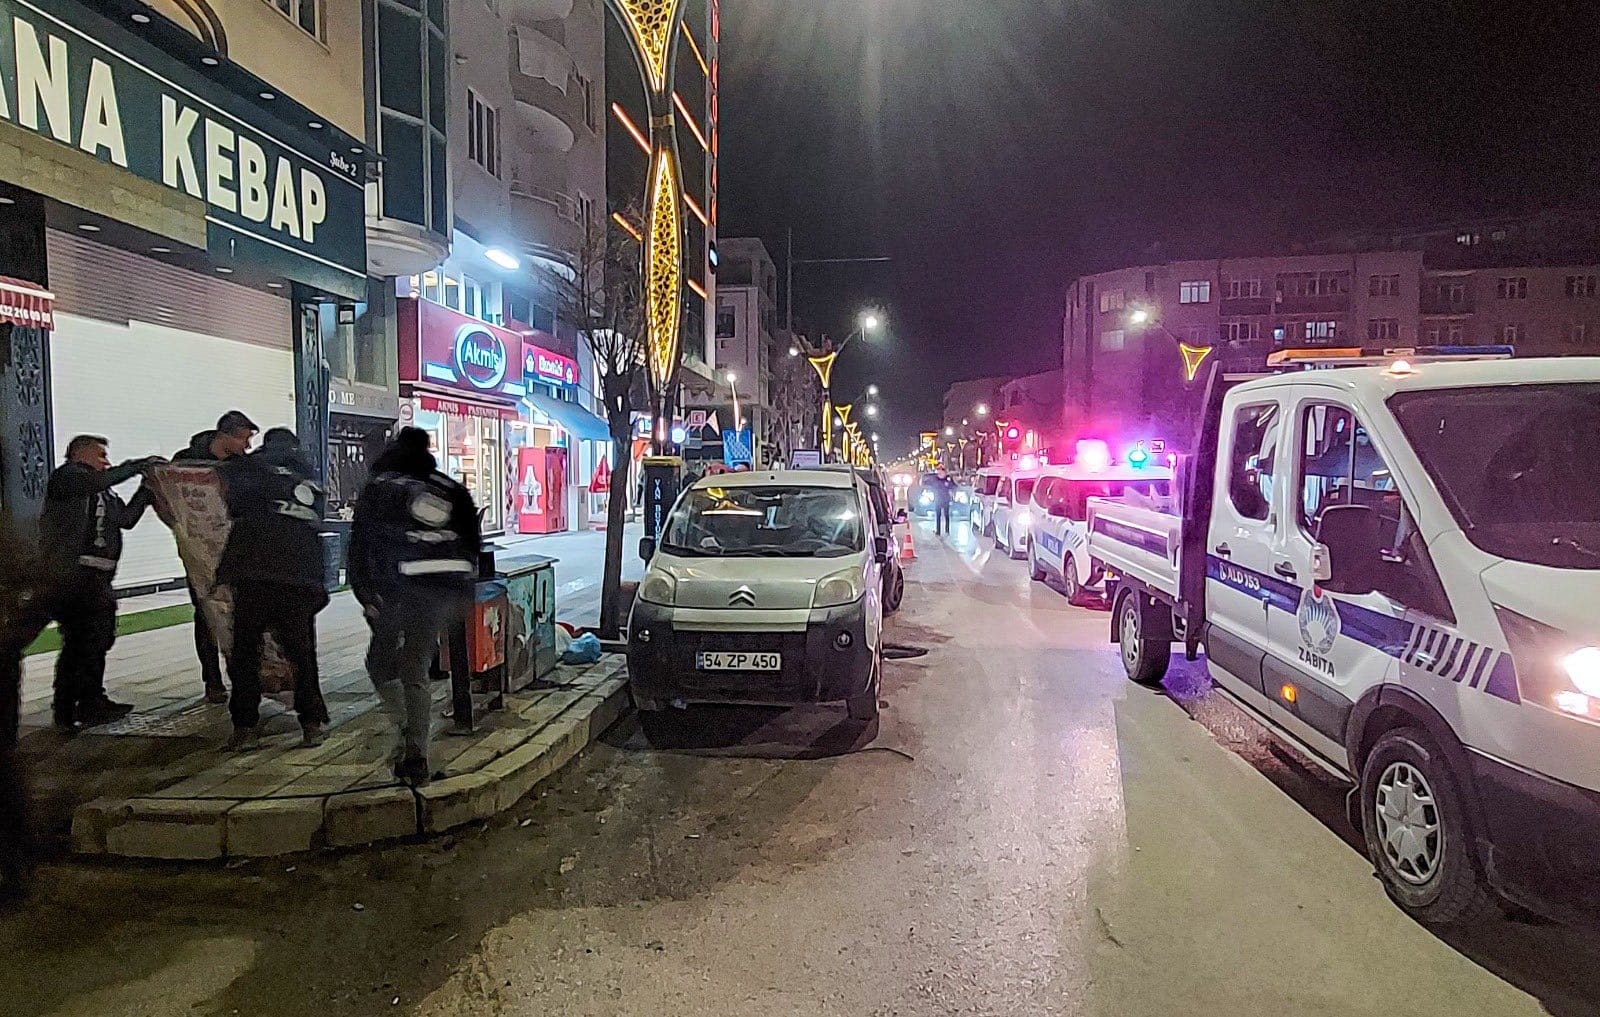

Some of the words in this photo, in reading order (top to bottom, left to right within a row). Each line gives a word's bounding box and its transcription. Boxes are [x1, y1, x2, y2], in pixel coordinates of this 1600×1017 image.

[0, 16, 128, 168] NA
[161, 93, 326, 244] KEBAP
[330, 151, 349, 172] Şube
[350, 163, 357, 177] 2
[1244, 573, 1260, 591] 153
[704, 653, 722, 668] 54
[726, 654, 748, 668] ZP
[751, 655, 778, 669] 450
[1297, 646, 1335, 679] ZABITA
